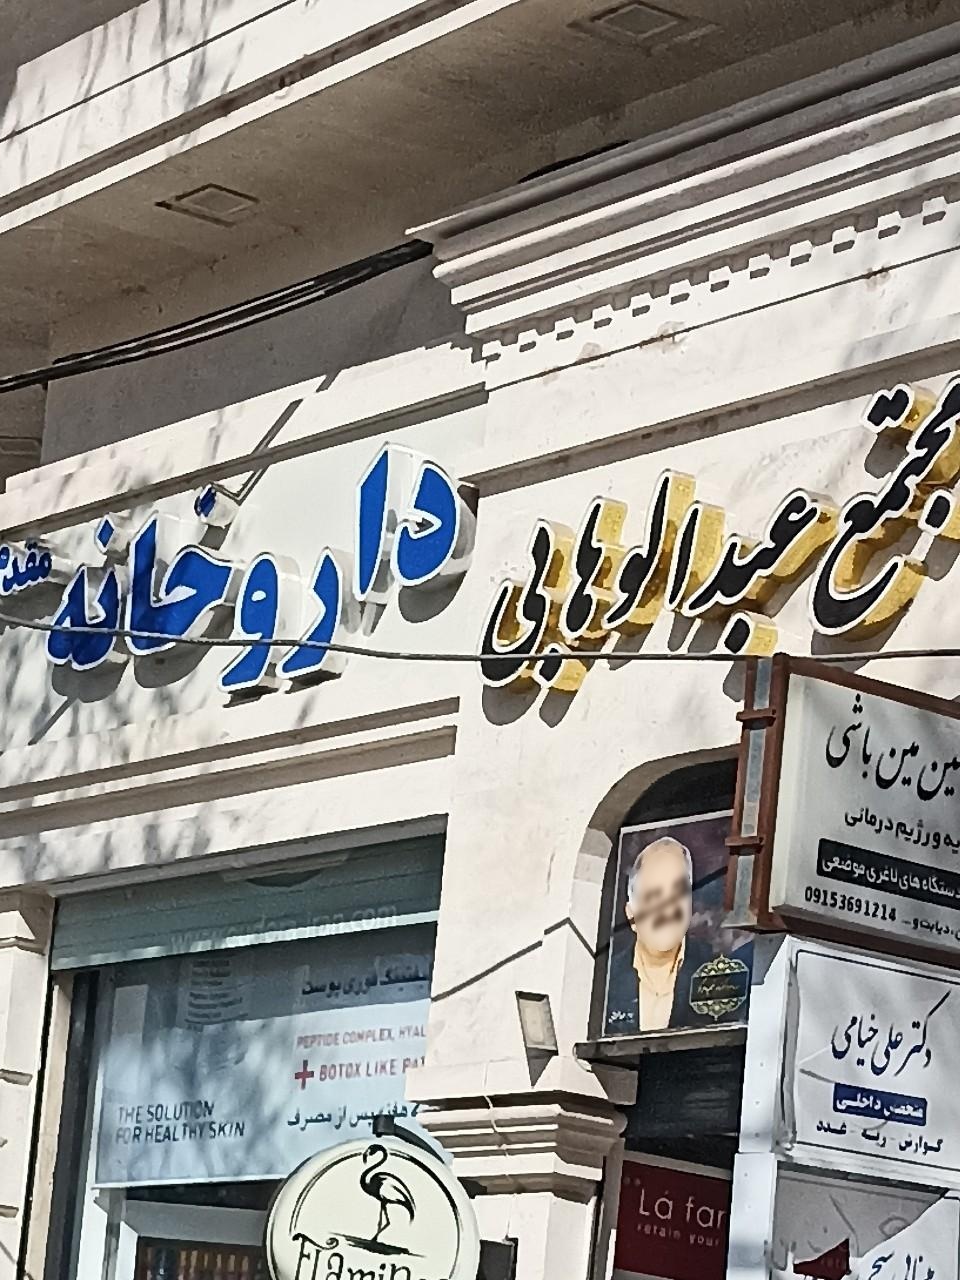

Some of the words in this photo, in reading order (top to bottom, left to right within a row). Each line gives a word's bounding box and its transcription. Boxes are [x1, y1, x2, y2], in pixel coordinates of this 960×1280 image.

[44, 442, 460, 692] داروخانه
[844, 807, 894, 833] درمانی
[804, 886, 897, 921] 09153691214
[296, 1032, 340, 1048] PEPTIDE
[893, 989, 952, 1077] دکتر
[870, 1022, 903, 1076] علی
[319, 1062, 362, 1082] BOTOX
[366, 1058, 397, 1077] LIKE
[119, 1105, 143, 1124] THE
[146, 1099, 215, 1122] SOLUTION
[116, 1125, 142, 1144] FOR
[145, 1121, 207, 1143] HEALTHY
[208, 1120, 245, 1139] SKIN
